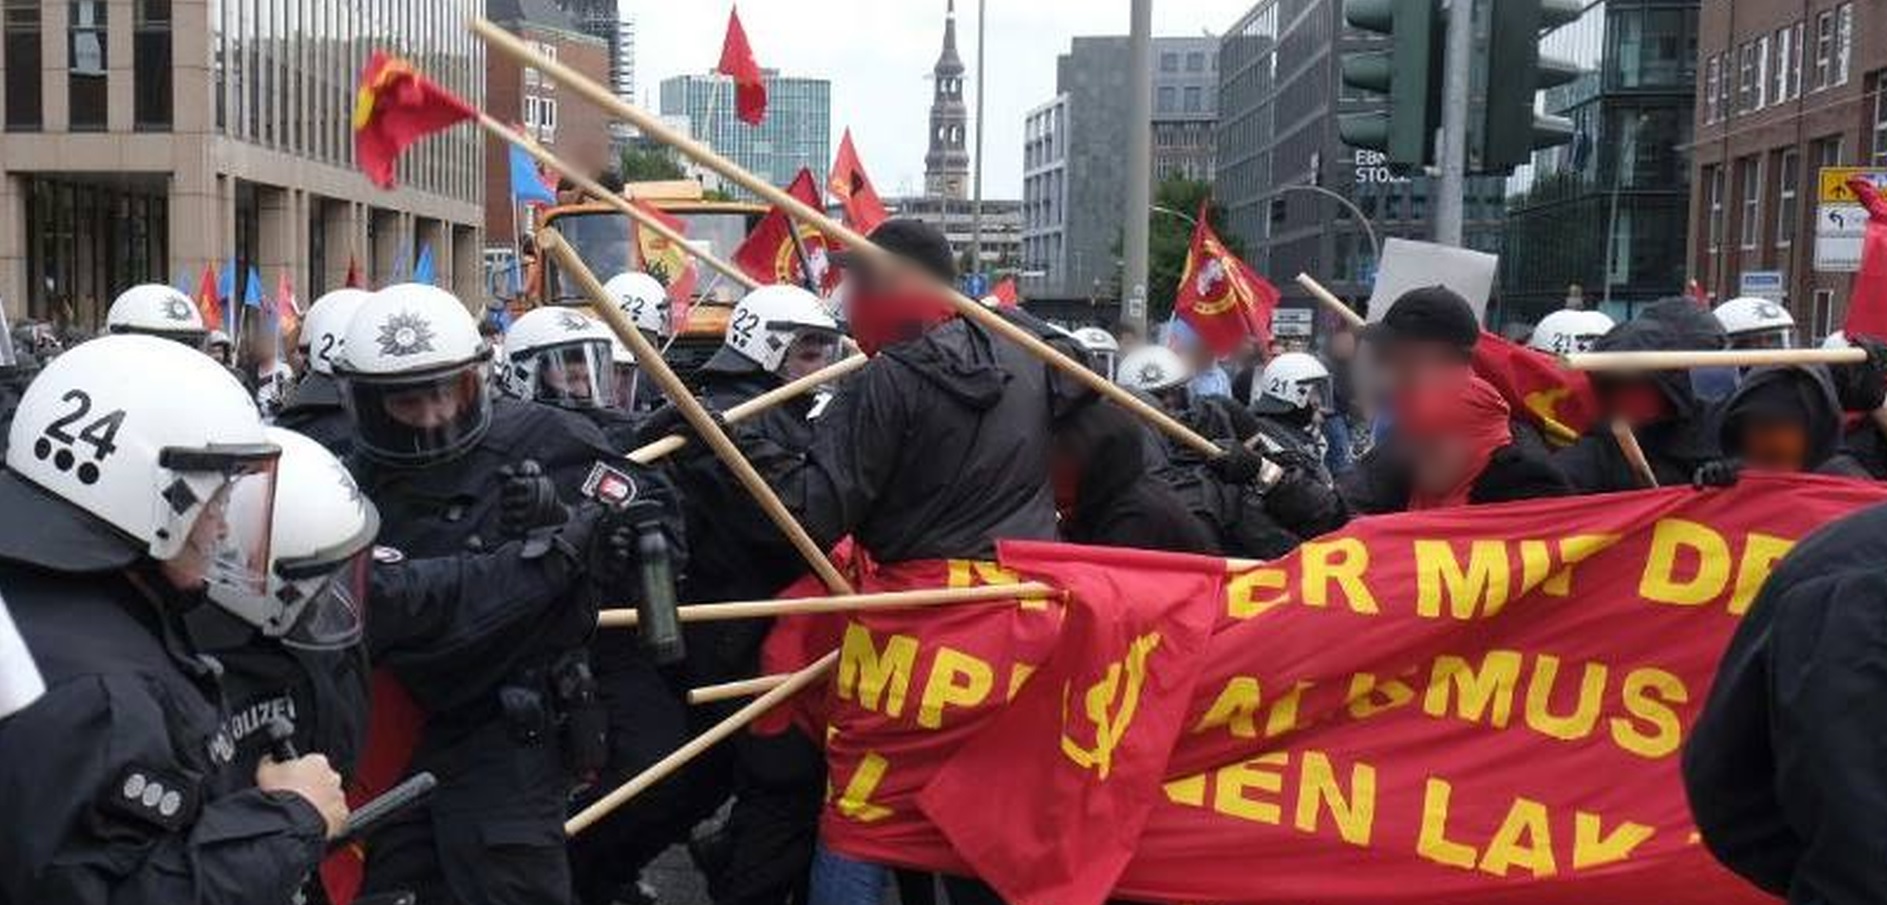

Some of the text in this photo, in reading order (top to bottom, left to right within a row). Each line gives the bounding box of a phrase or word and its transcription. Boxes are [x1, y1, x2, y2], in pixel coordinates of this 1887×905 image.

[733, 308, 759, 338] 22
[1269, 377, 1289, 395] 21
[44, 388, 127, 462] 24
